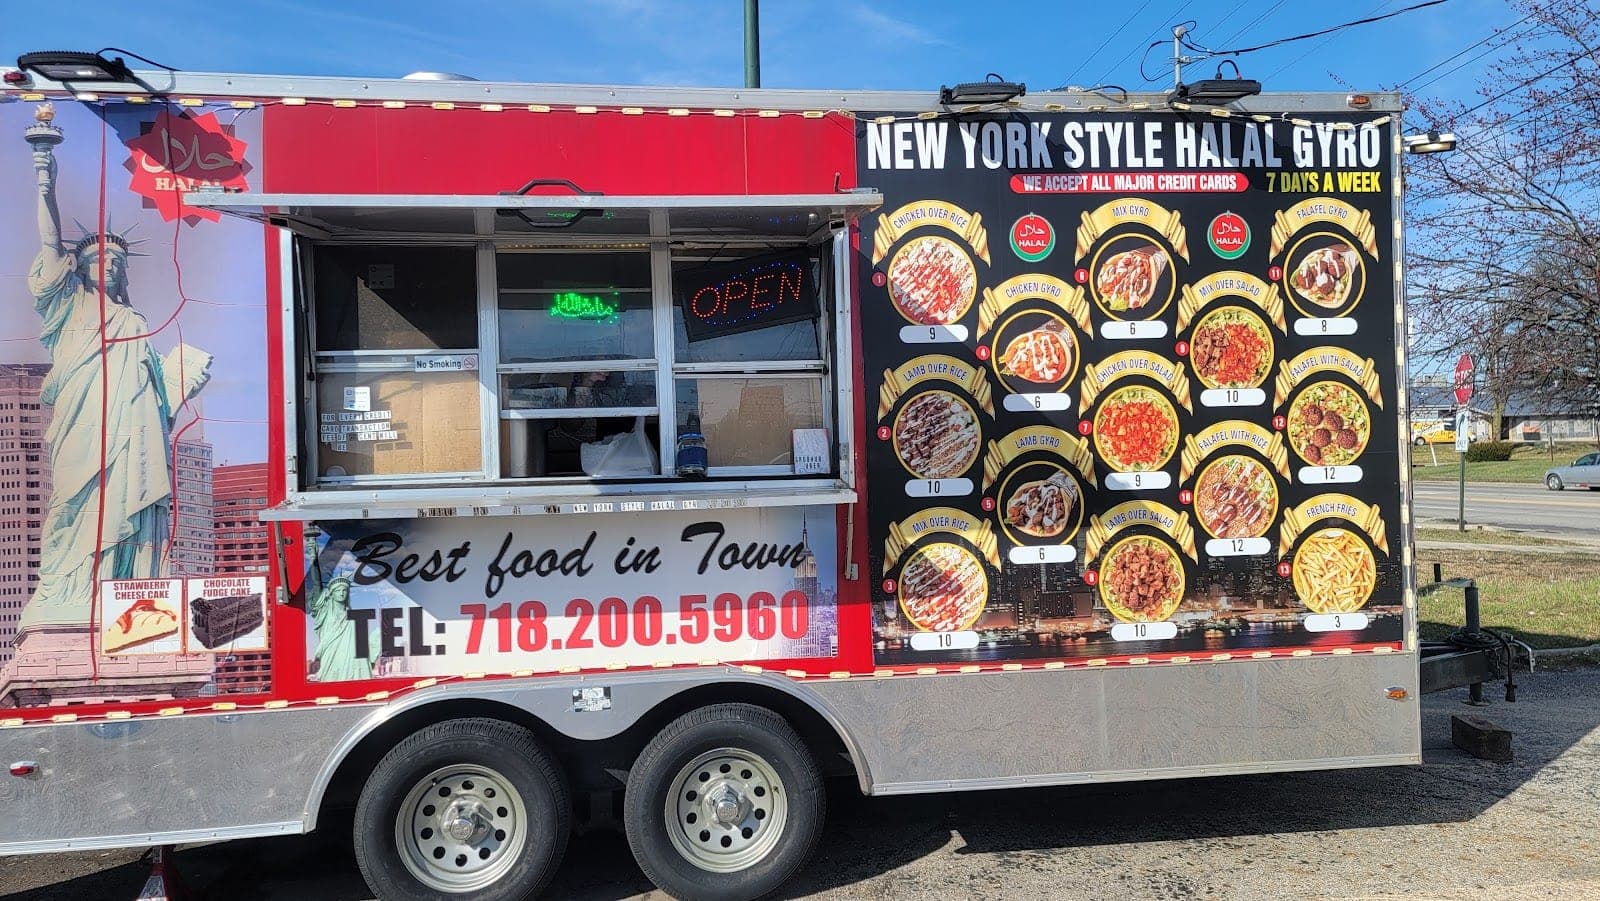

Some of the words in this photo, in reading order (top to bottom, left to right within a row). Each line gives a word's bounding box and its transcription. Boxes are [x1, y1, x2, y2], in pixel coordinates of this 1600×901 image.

[141, 128, 236, 173] حلال
[867, 122, 948, 169] NEW
[959, 122, 1054, 169] YORK
[1063, 121, 1164, 169] STYLE
[1175, 121, 1282, 168] HALAL
[1292, 122, 1381, 168] GYRO
[1023, 175, 1042, 191] WE
[1044, 175, 1089, 191] ACCEPT
[1091, 175, 1112, 190] ALL
[1114, 175, 1155, 190] MAJOR
[1157, 174, 1197, 190] CREDIT
[1199, 174, 1237, 190] CARDS
[1266, 172, 1275, 193] 7
[1280, 172, 1319, 193] DAYS
[1322, 172, 1335, 193] A
[1337, 172, 1381, 192] WEEK
[893, 207, 926, 229] CHICKEN
[928, 206, 949, 219] OVER
[949, 211, 968, 229] RICE
[1111, 205, 1128, 217] MIX
[1129, 205, 1150, 217] GYRO
[1296, 204, 1327, 219] FALAFEL
[1328, 205, 1348, 219] GYRO
[1020, 224, 1045, 236] حلال
[1216, 222, 1242, 235] حلال
[1216, 237, 1243, 245] HALAL
[876, 275, 882, 284] 1
[1269, 269, 1280, 278] 11
[692, 269, 802, 319] OPEN
[1005, 282, 1038, 298] CHICKEN
[1040, 282, 1061, 297] GYRO
[1198, 282, 1214, 297] MIX
[1215, 279, 1234, 291] OVER
[1235, 280, 1260, 297] SALAD
[1129, 322, 1136, 335] 6
[1321, 320, 1328, 332] 8
[928, 327, 936, 340] 9
[979, 348, 987, 357] 4
[416, 359, 427, 369] No
[429, 358, 462, 370] Smoking
[1097, 360, 1127, 383] CHICKEN
[1129, 358, 1149, 371] OVER
[1149, 360, 1174, 382] SALAD
[1291, 355, 1319, 377] FALAFEL
[1320, 354, 1339, 366] WITH
[1340, 356, 1364, 377] SALAD
[903, 365, 926, 382] LAMB
[928, 363, 948, 374] OVER
[949, 365, 968, 381] RICE
[1034, 396, 1041, 409] 6
[1226, 389, 1239, 403] 10
[1082, 423, 1089, 432] 7
[1274, 419, 1285, 428] 12
[881, 429, 888, 438] 2
[1199, 431, 1228, 449] FALAFEL
[1229, 429, 1249, 441] WITH
[1249, 431, 1268, 449] RICE
[1015, 435, 1037, 448] LAMB
[1039, 435, 1060, 448] GYRO
[1323, 467, 1336, 480] 12
[927, 480, 941, 494] 10
[1135, 474, 1142, 487] 9
[985, 499, 992, 509] 5
[1306, 504, 1335, 518] FRENCH
[1337, 503, 1357, 517] FRIES
[912, 519, 929, 533] MIX
[930, 517, 949, 528] OVER
[951, 519, 970, 532] RICE
[1104, 512, 1126, 530] LAMB
[1128, 510, 1148, 522] OVER
[1150, 511, 1174, 528] SALAD
[1231, 539, 1244, 552] 12
[348, 532, 471, 585] Best
[486, 531, 597, 598] food
[615, 537, 661, 575] in
[680, 521, 807, 575] Town
[1039, 548, 1046, 560] 6
[1279, 564, 1290, 574] 13
[113, 581, 171, 591] STRAWBERRY
[203, 579, 250, 588] CHOCOLATE
[887, 581, 894, 590] 3
[115, 590, 146, 600] CHEESE
[147, 590, 169, 599] CAKE
[202, 588, 229, 597] FUDGE
[230, 587, 251, 596] CAKE
[347, 607, 446, 659] TEL:
[460, 590, 810, 655] 718.200.5960
[1334, 615, 1342, 628] 3
[1134, 624, 1147, 637] 10
[938, 633, 952, 647] 10
